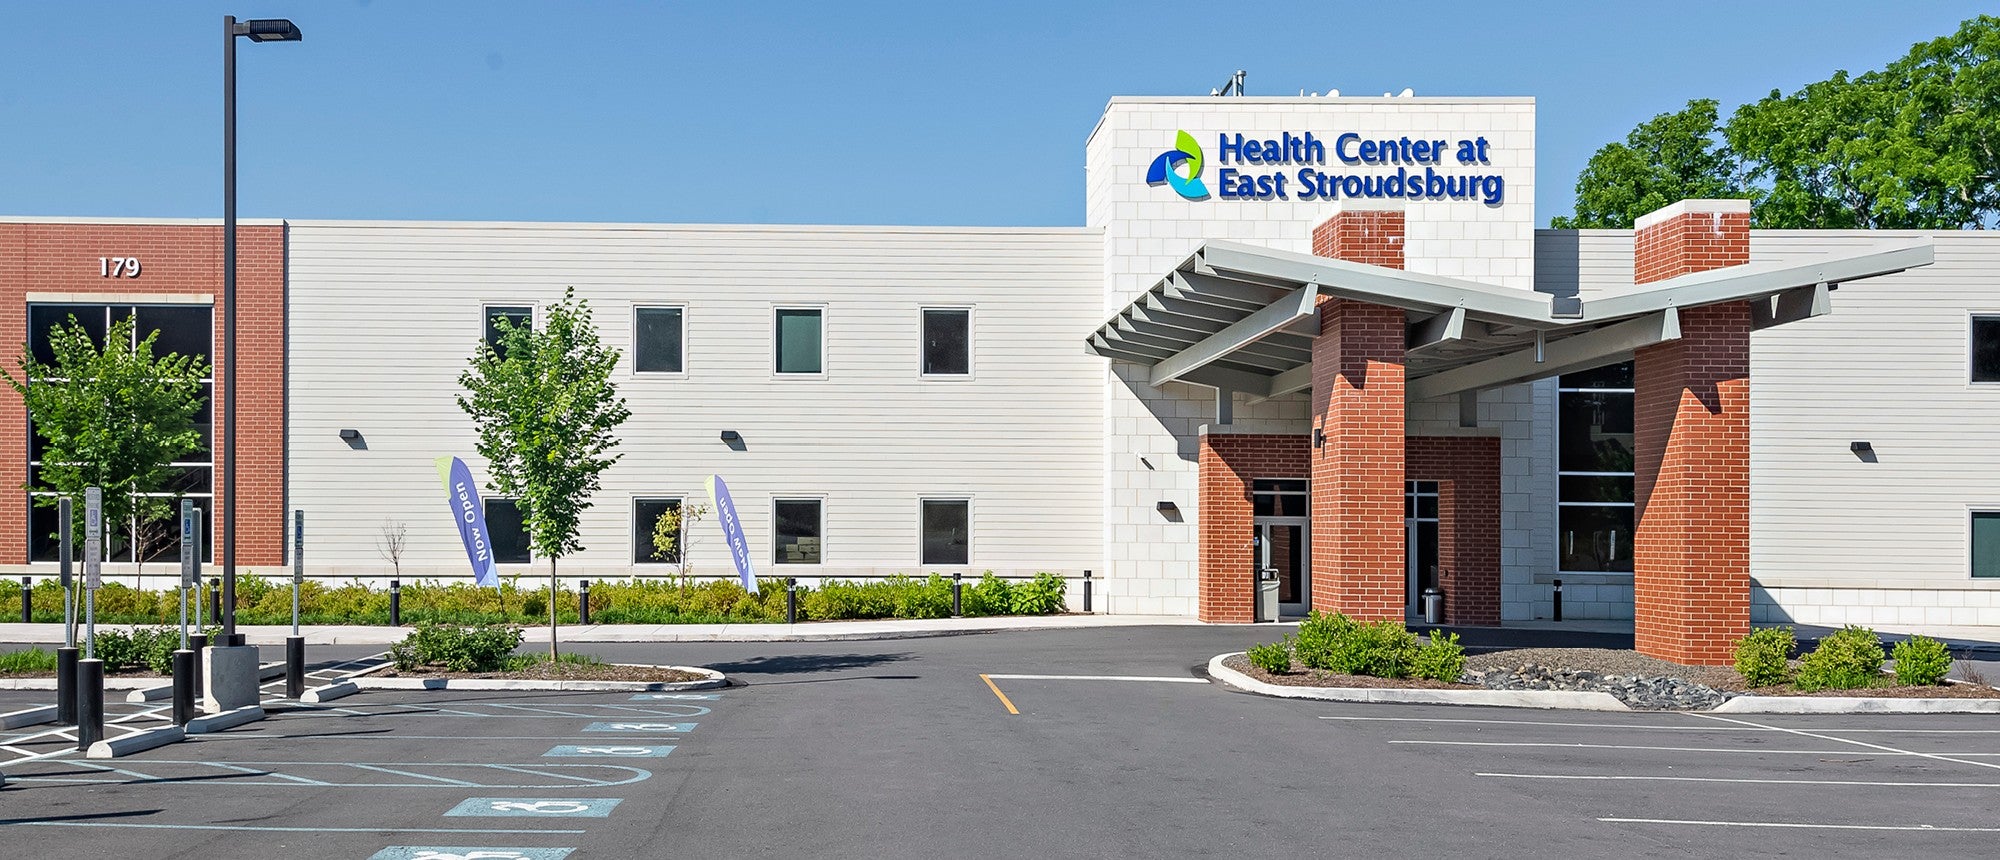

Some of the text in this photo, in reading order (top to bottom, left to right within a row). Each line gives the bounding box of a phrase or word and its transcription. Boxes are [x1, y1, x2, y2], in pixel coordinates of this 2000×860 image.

[1219, 131, 1491, 166] Health Center at
[1219, 167, 1504, 208] East Stroudsburg
[99, 256, 142, 278] 179
[456, 481, 488, 562] Now Open
[719, 497, 748, 570] Now Open
